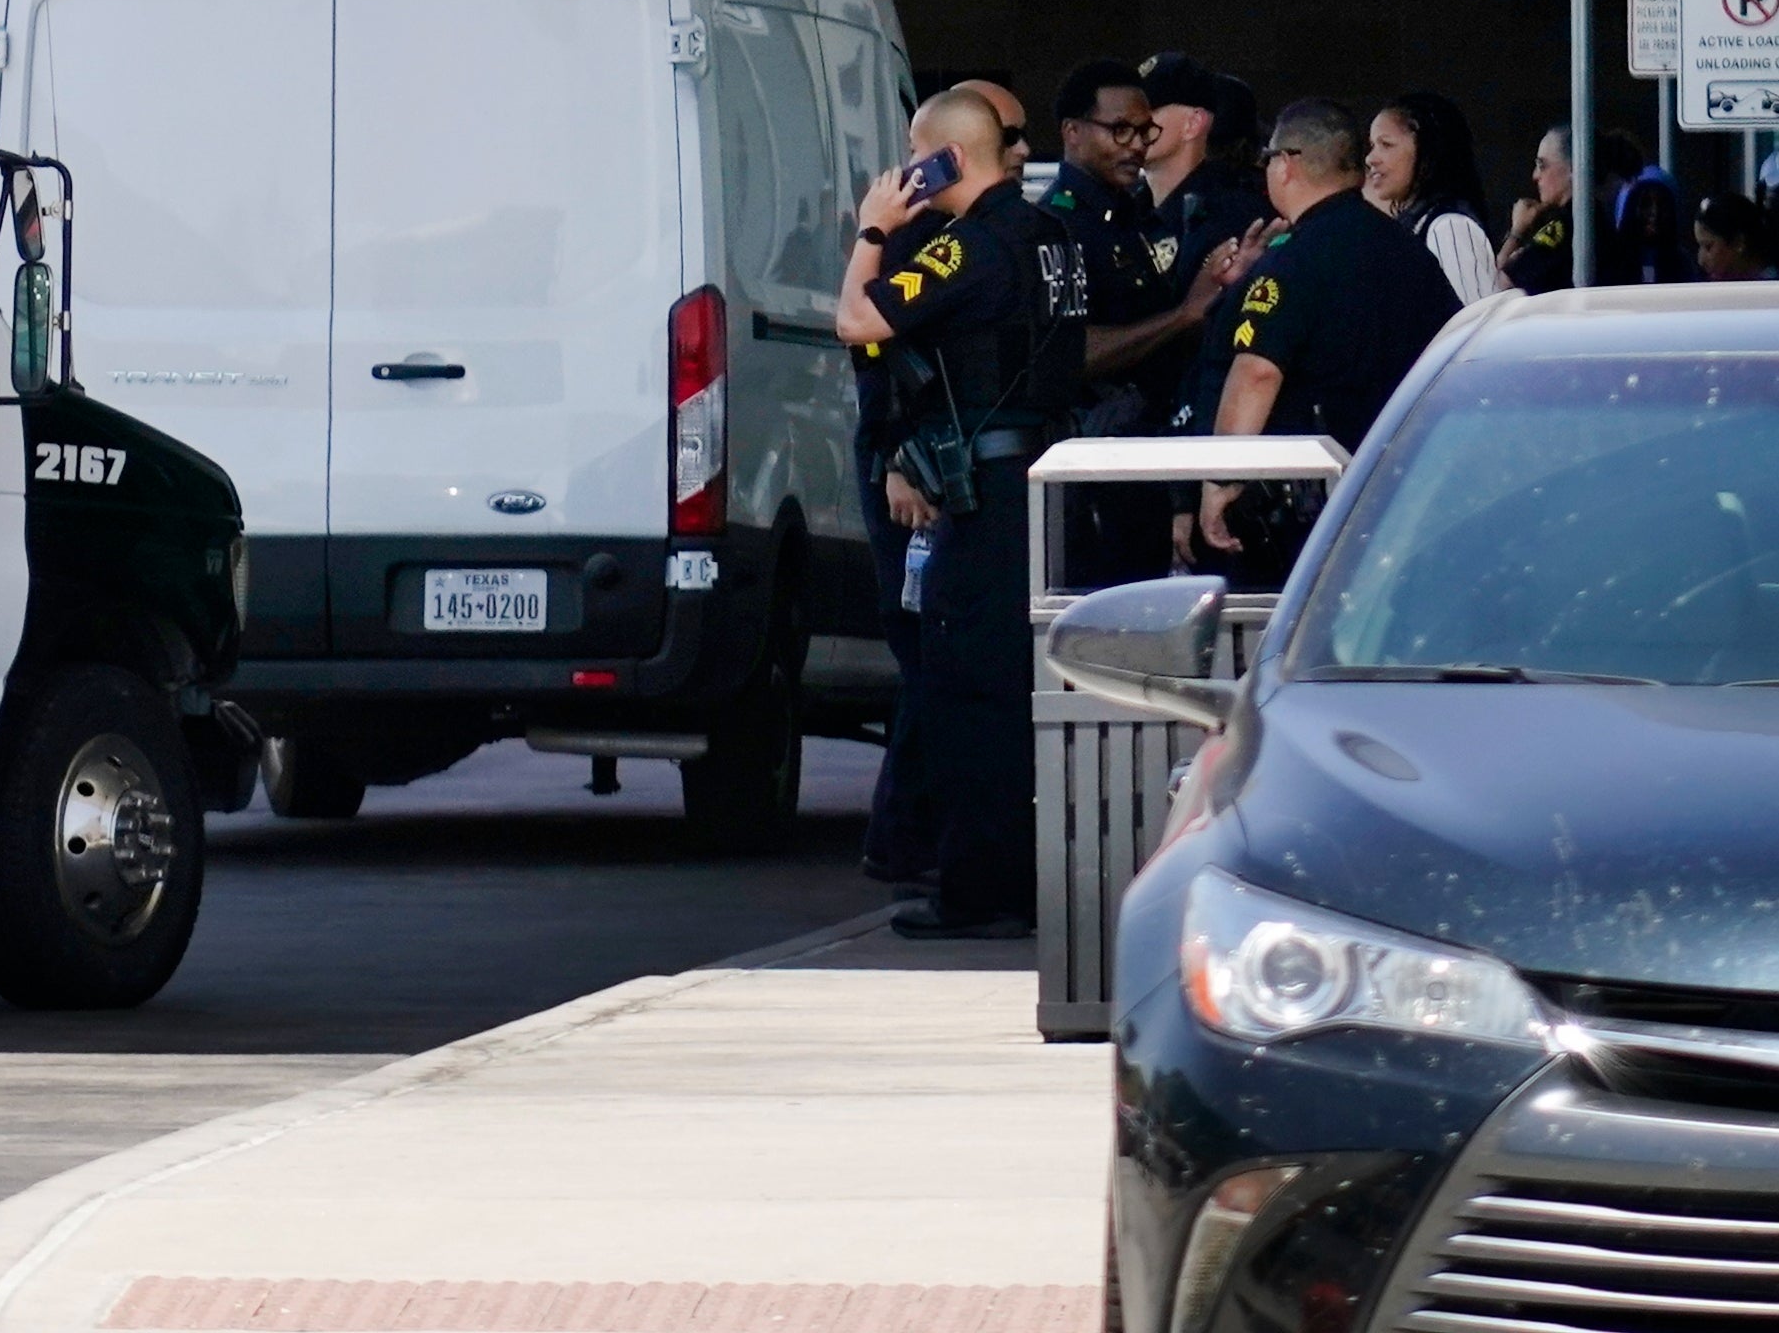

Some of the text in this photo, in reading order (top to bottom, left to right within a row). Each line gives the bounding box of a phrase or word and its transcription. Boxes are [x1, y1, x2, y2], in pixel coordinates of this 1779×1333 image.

[1698, 35, 1779, 47] ACTIVE LOAD
[1696, 58, 1772, 70] UNLOADING
[34, 442, 127, 485] 2167
[464, 574, 510, 586] TEXAS
